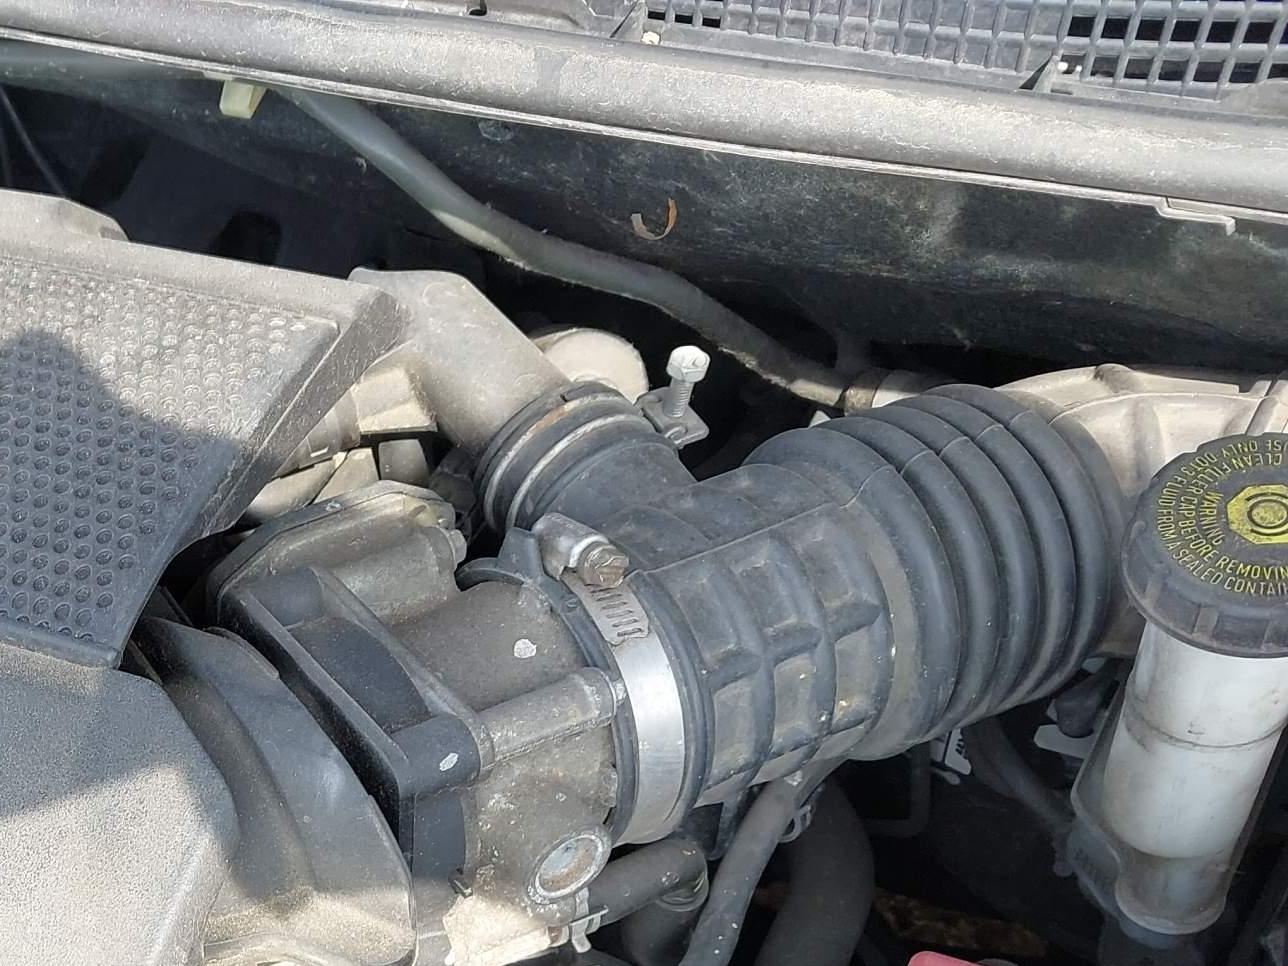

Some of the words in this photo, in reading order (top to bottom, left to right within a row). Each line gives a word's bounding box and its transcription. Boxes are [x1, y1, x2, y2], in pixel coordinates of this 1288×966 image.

[1222, 440, 1258, 456] ONLY
[1232, 453, 1282, 470] CLEAN
[1158, 475, 1187, 506] FLUID
[1188, 462, 1232, 495] FILLER
[1178, 495, 1198, 521] CAP
[1199, 491, 1225, 545] WARNING
[1157, 509, 1177, 541] FROM
[1167, 541, 1181, 550] A
[1178, 520, 1220, 562] BEFORE
[1172, 550, 1224, 585] SEALED
